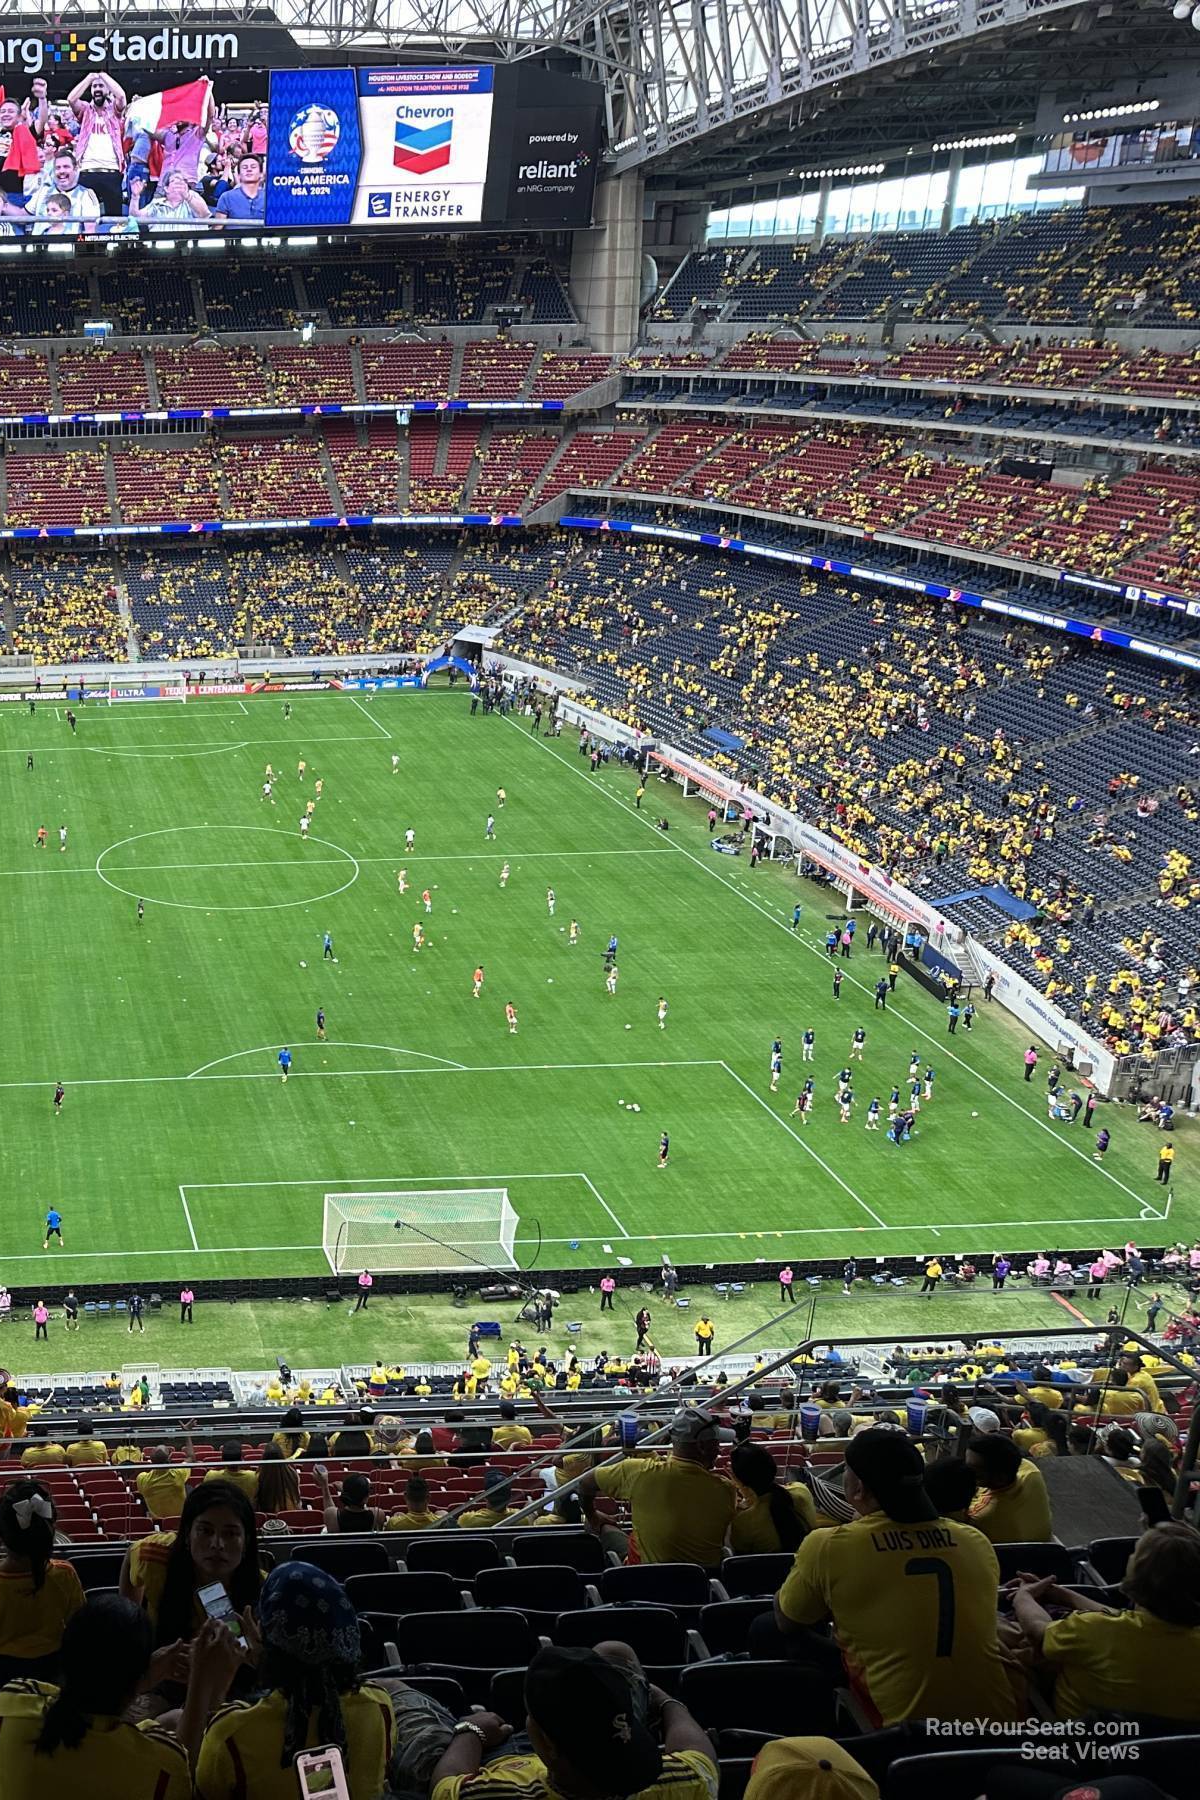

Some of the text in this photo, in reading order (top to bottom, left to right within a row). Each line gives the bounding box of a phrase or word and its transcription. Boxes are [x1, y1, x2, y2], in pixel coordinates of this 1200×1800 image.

[87, 28, 239, 61] stadium
[396, 105, 454, 118] Chevron
[529, 133, 578, 144] powered by
[518, 160, 577, 179] reliant
[273, 174, 350, 186] COPA AMERICA
[291, 187, 331, 196] USA 2024
[527, 185, 543, 193] NRG
[543, 185, 575, 194] company
[395, 190, 451, 203] ENERGY
[395, 204, 463, 217] TRANSFER
[117, 688, 145, 697] ULTRA
[1047, 1016, 1060, 1034] COPA
[1058, 1027, 1079, 1046] AMERICA
[870, 1527, 958, 1552] LUIS DIAZ
[904, 1556, 955, 1658] 7
